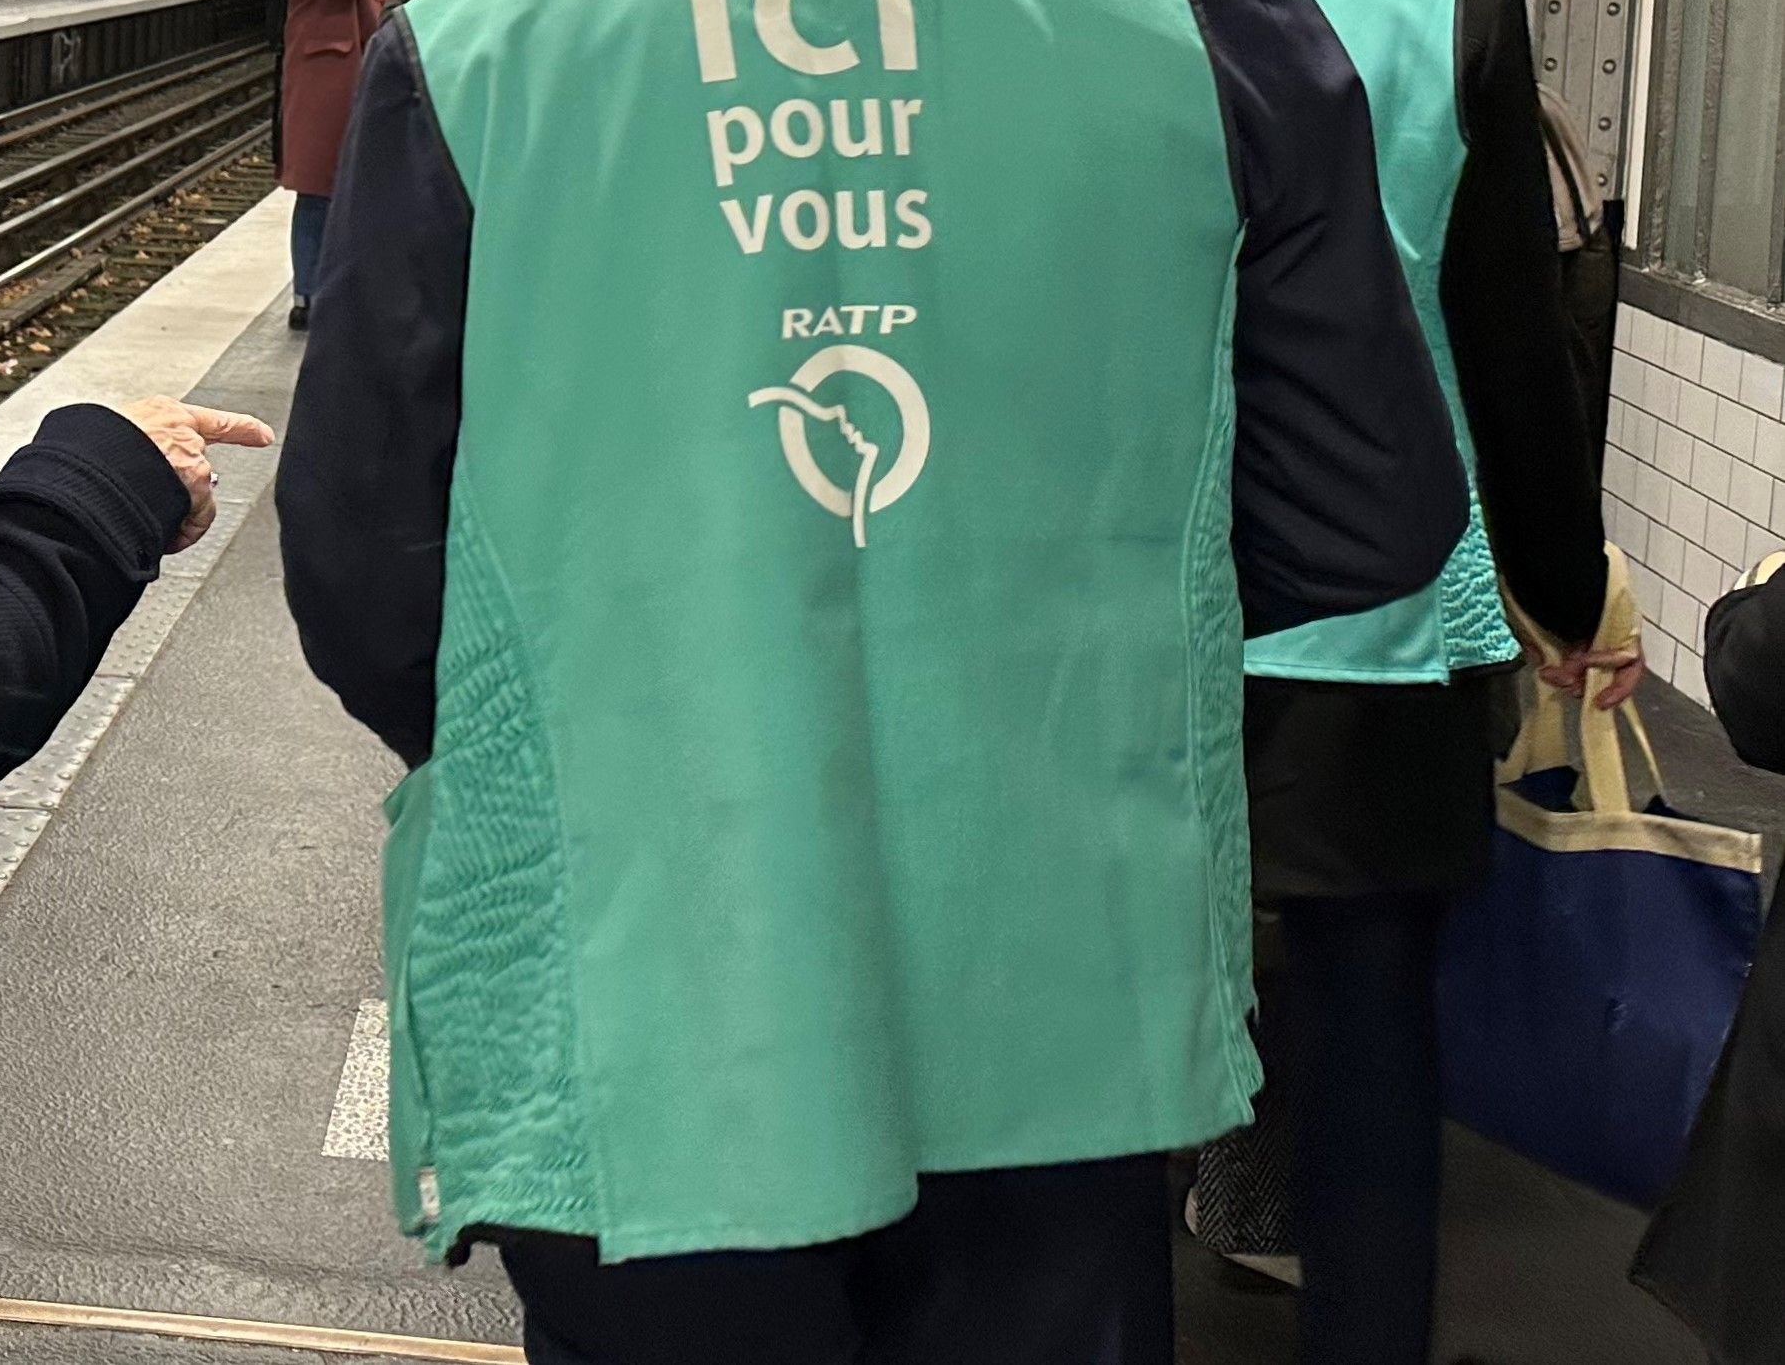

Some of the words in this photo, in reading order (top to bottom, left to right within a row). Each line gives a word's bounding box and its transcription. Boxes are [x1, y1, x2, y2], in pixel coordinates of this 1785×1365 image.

[705, 97, 924, 188] pour
[718, 188, 933, 255] vous
[780, 304, 917, 339] RATP
